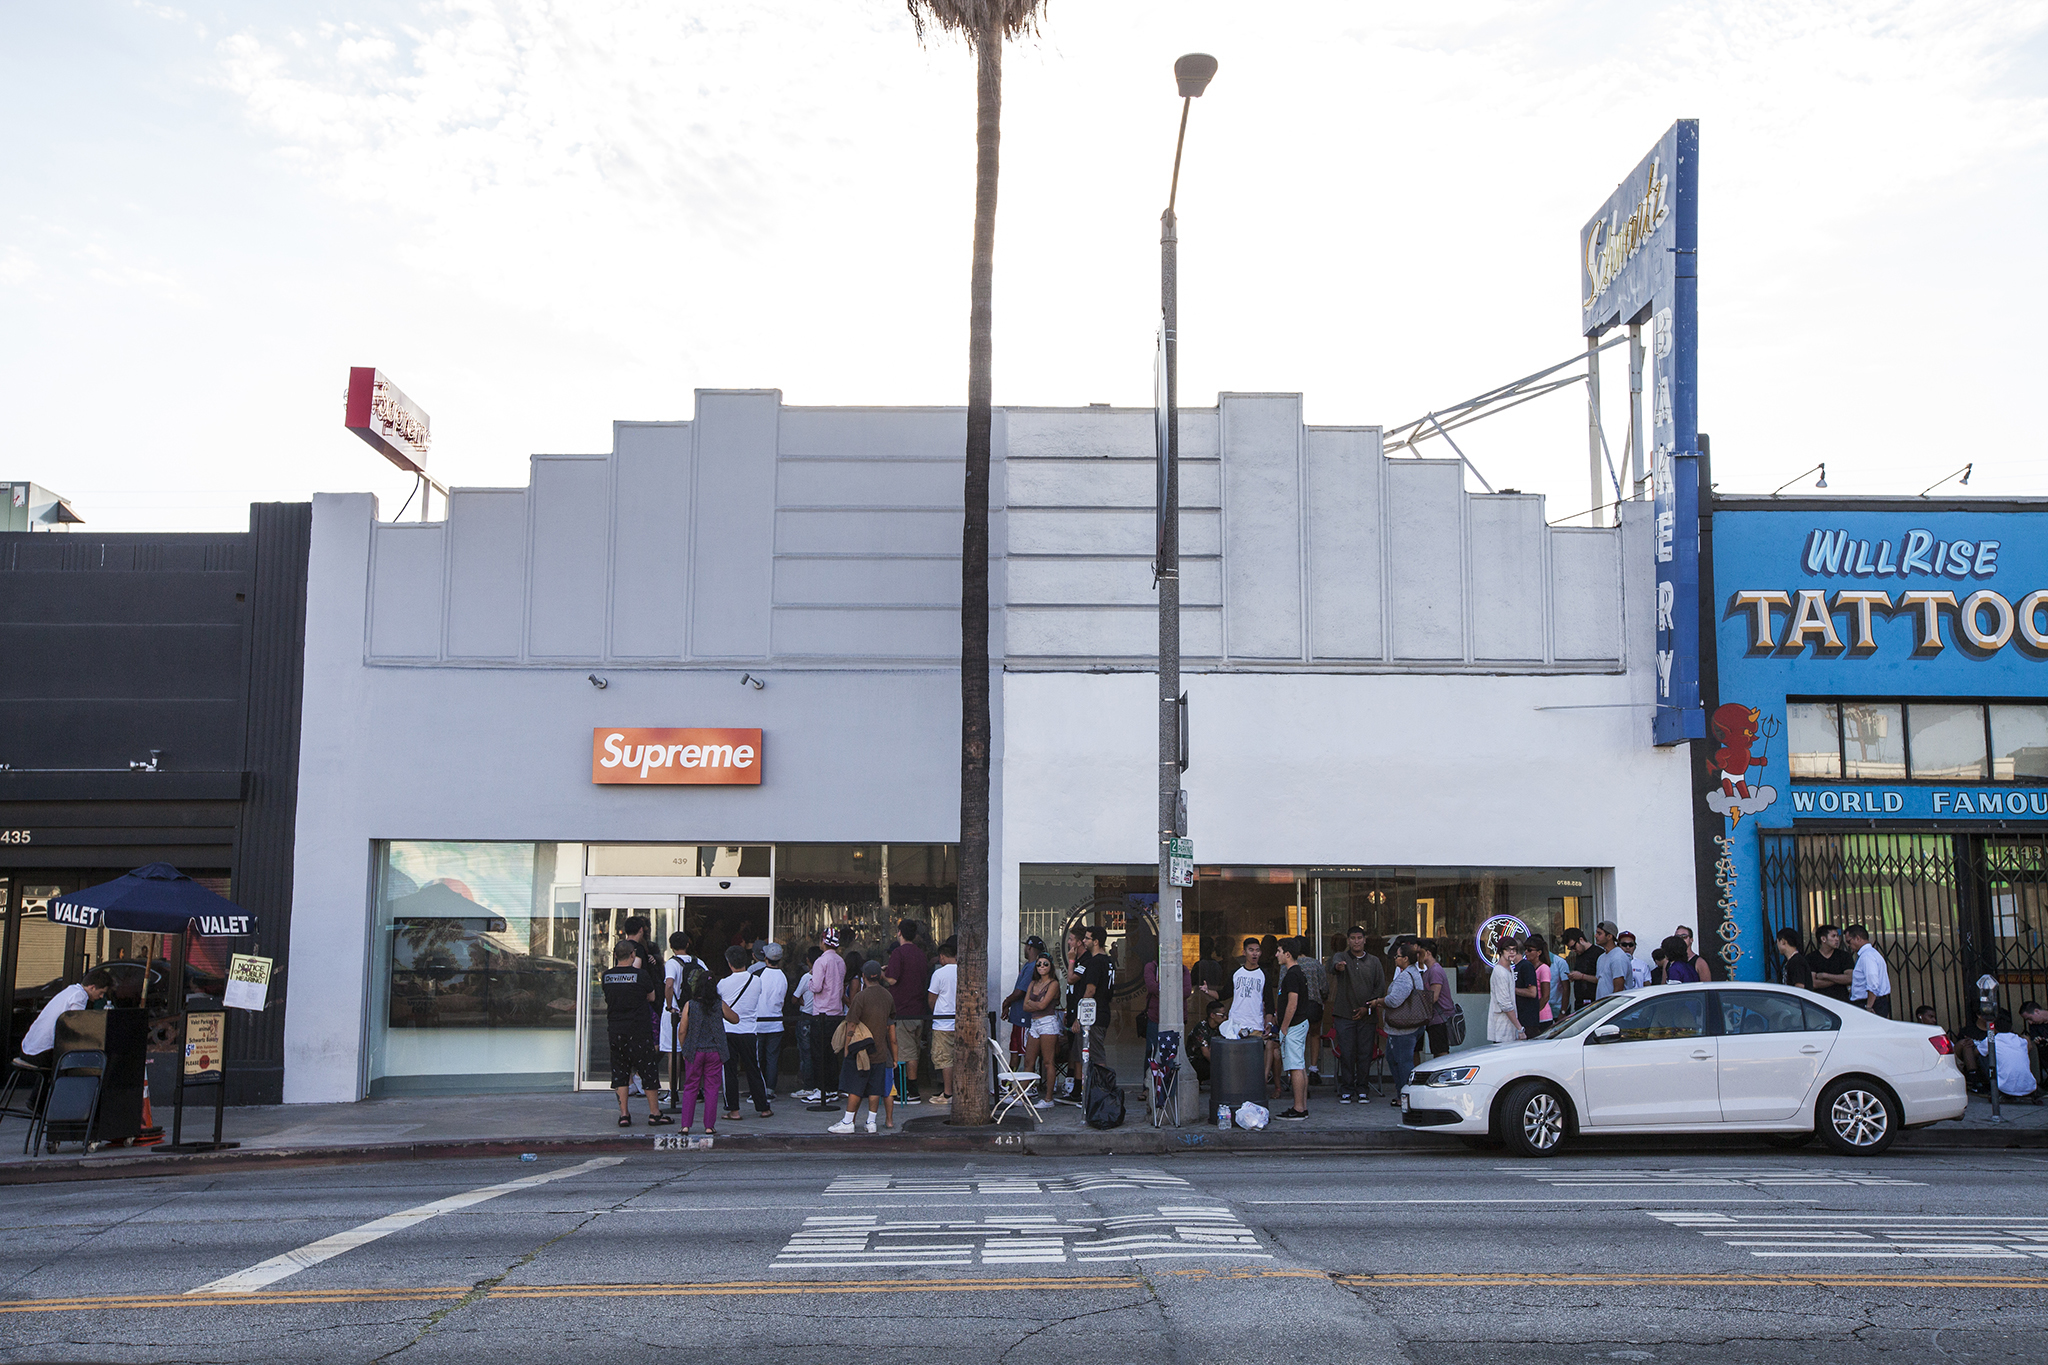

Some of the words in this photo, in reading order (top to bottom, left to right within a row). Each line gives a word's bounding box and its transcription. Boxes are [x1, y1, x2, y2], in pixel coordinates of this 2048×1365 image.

[1655, 307, 1674, 697] BAKERY
[1733, 588, 2048, 651] TATTOO
[600, 733, 754, 778] Supreme
[1792, 791, 1904, 813] WORLD
[0, 830, 31, 844] 435
[54, 902, 99, 925] VALET
[1066, 903, 1080, 917] GIRL
[200, 915, 249, 934] VALET
[237, 963, 265, 972] NOTICE
[241, 970, 266, 979] PUBLIC
